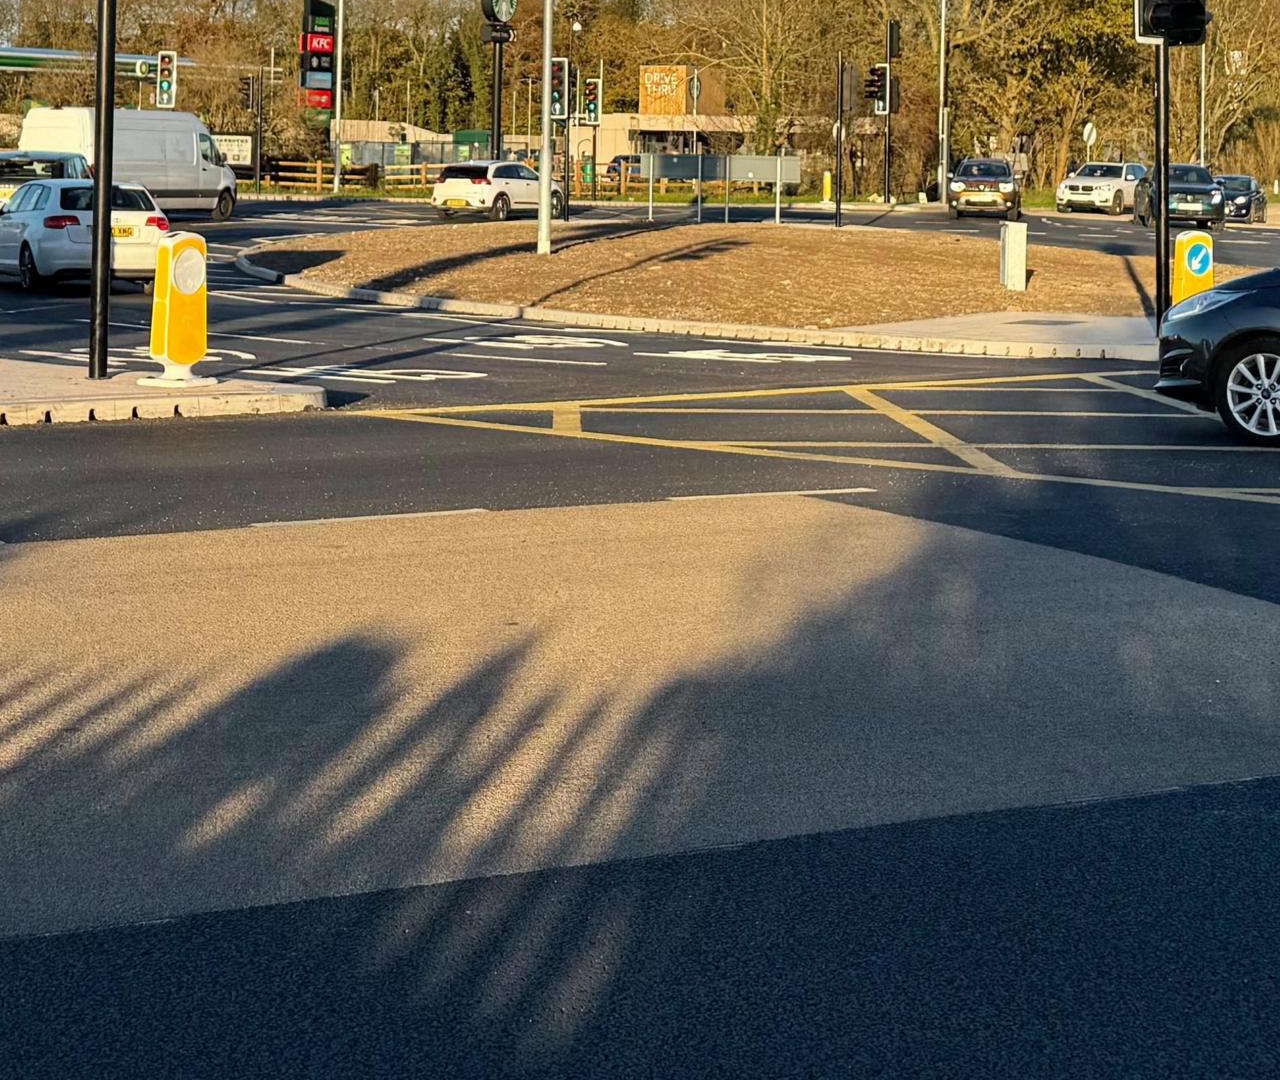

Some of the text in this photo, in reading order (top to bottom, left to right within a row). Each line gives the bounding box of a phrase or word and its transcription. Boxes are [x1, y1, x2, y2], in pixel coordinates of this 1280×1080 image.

[311, 37, 330, 49] KFC
[644, 72, 679, 84] DRIVE
[646, 84, 677, 96] THRU
